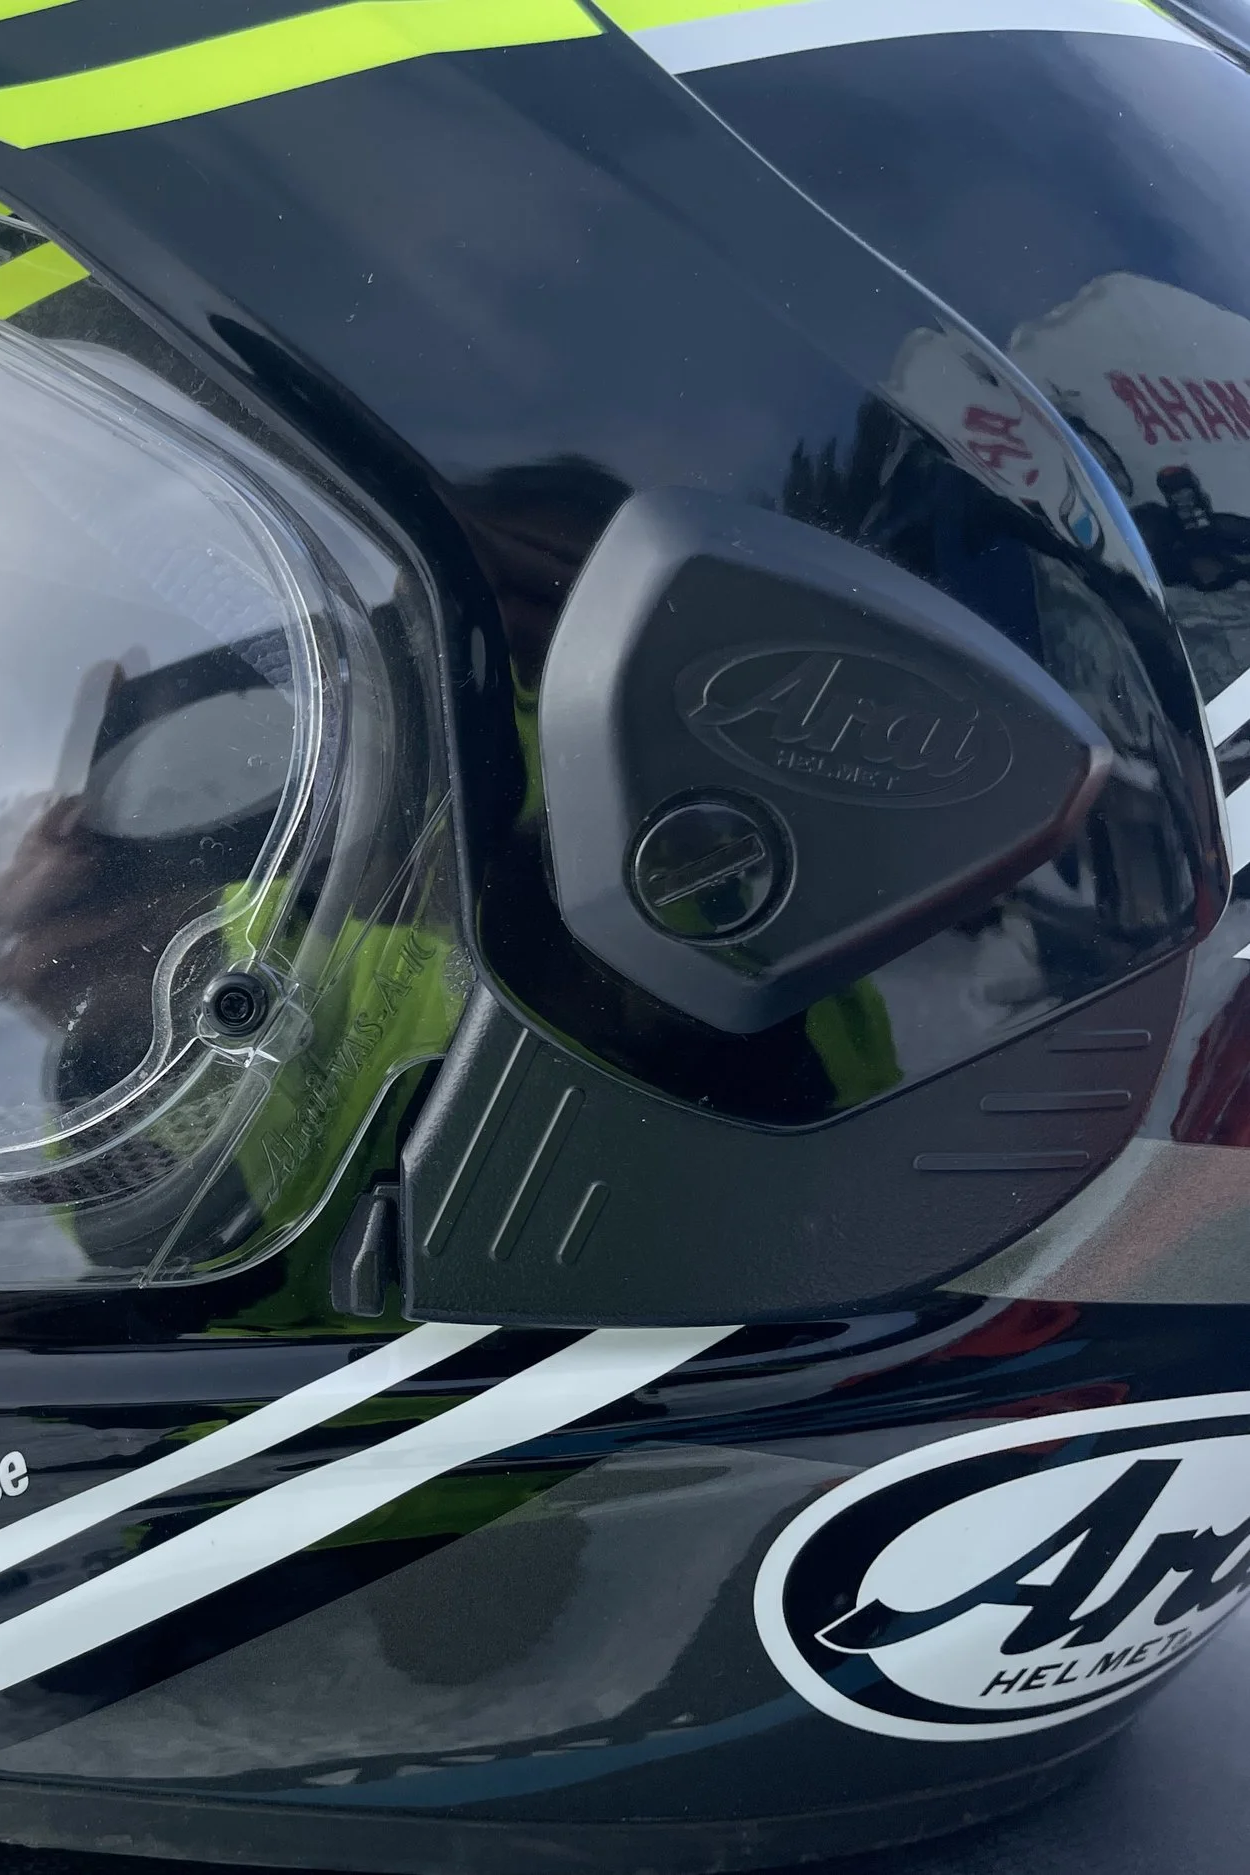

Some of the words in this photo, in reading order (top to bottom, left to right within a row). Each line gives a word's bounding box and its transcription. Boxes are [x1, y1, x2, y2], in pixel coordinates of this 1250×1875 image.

[688, 653, 977, 778] Arai
[814, 1458, 1250, 1656] Ara
[980, 1627, 1190, 1697] HELMET
